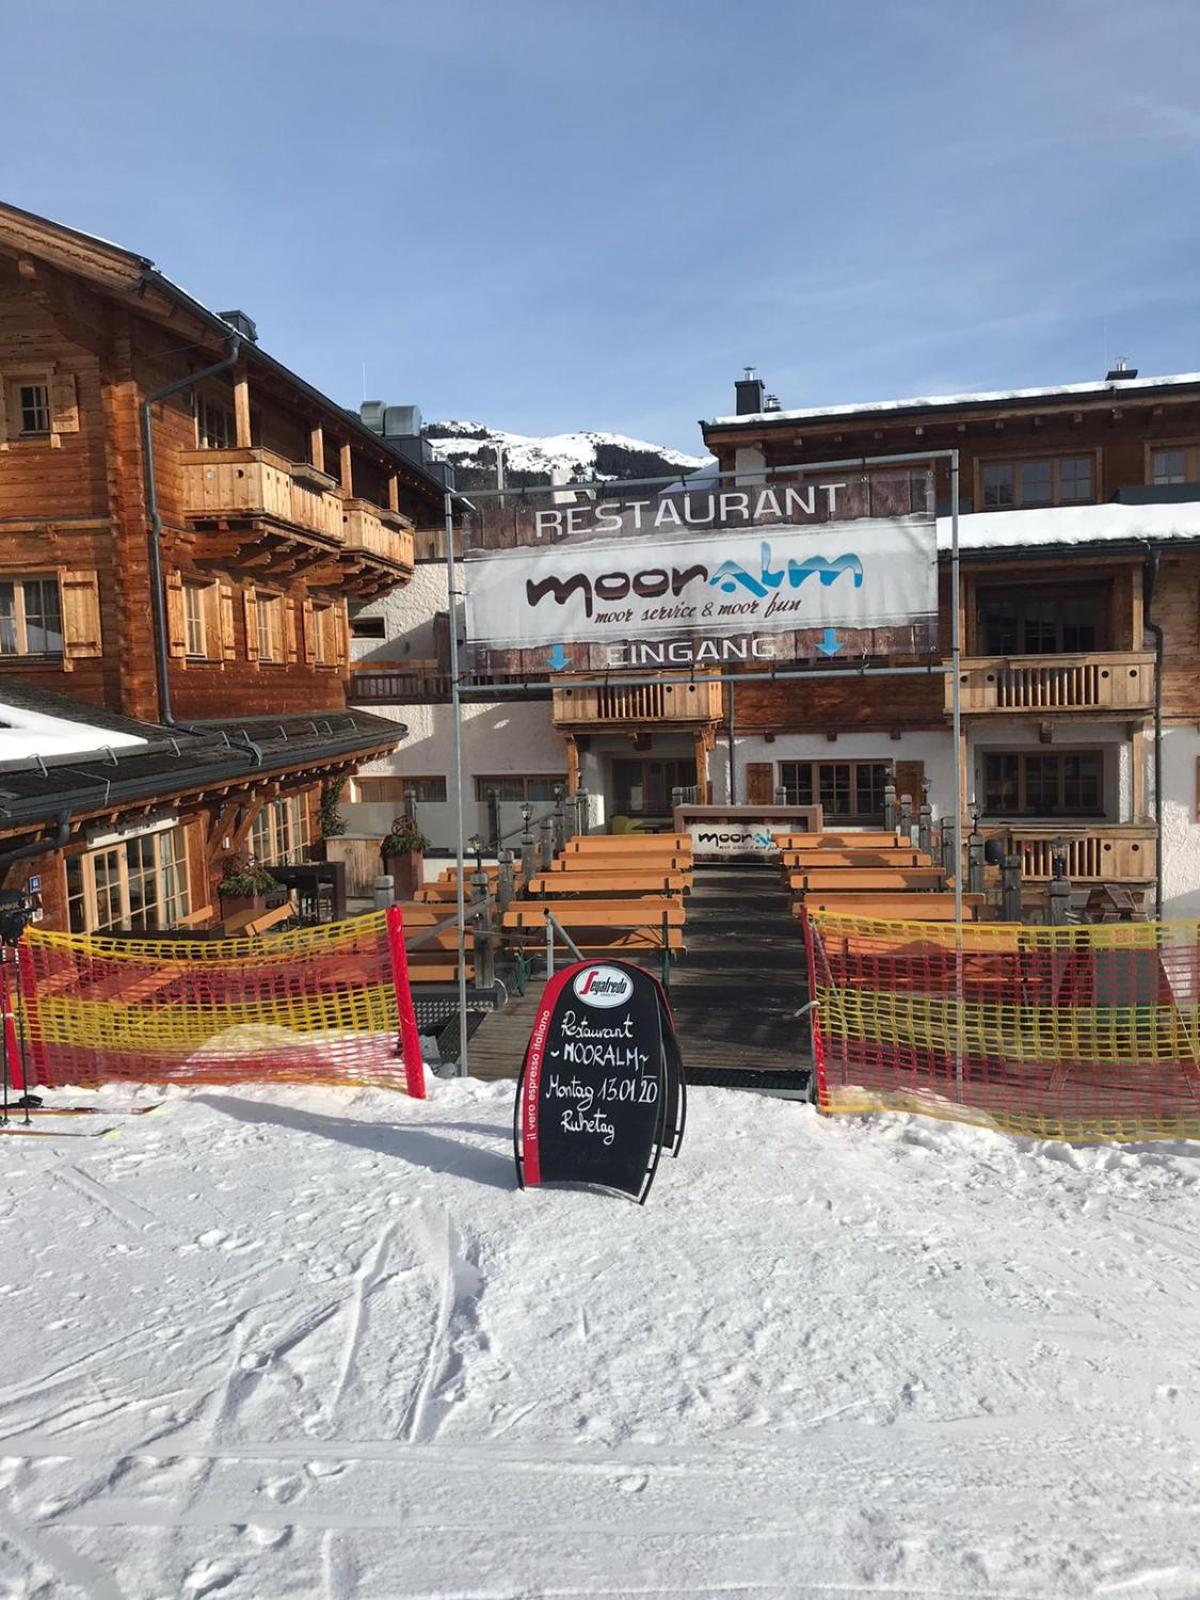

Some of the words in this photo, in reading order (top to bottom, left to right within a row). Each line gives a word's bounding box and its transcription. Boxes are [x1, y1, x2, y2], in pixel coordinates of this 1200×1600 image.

[534, 483, 848, 538] RESTAURANT
[594, 609, 633, 624] moor
[641, 601, 697, 622] service
[701, 602, 712, 617] &
[718, 600, 759, 616] moor
[764, 592, 803, 618] fun
[606, 637, 777, 667] EINGANG
[579, 970, 628, 996] Segafredo
[561, 1010, 634, 1039] Restaurant
[546, 1073, 595, 1112] Montag
[527, 1132, 537, 1141] il
[560, 1108, 616, 1146] Ruhetag
